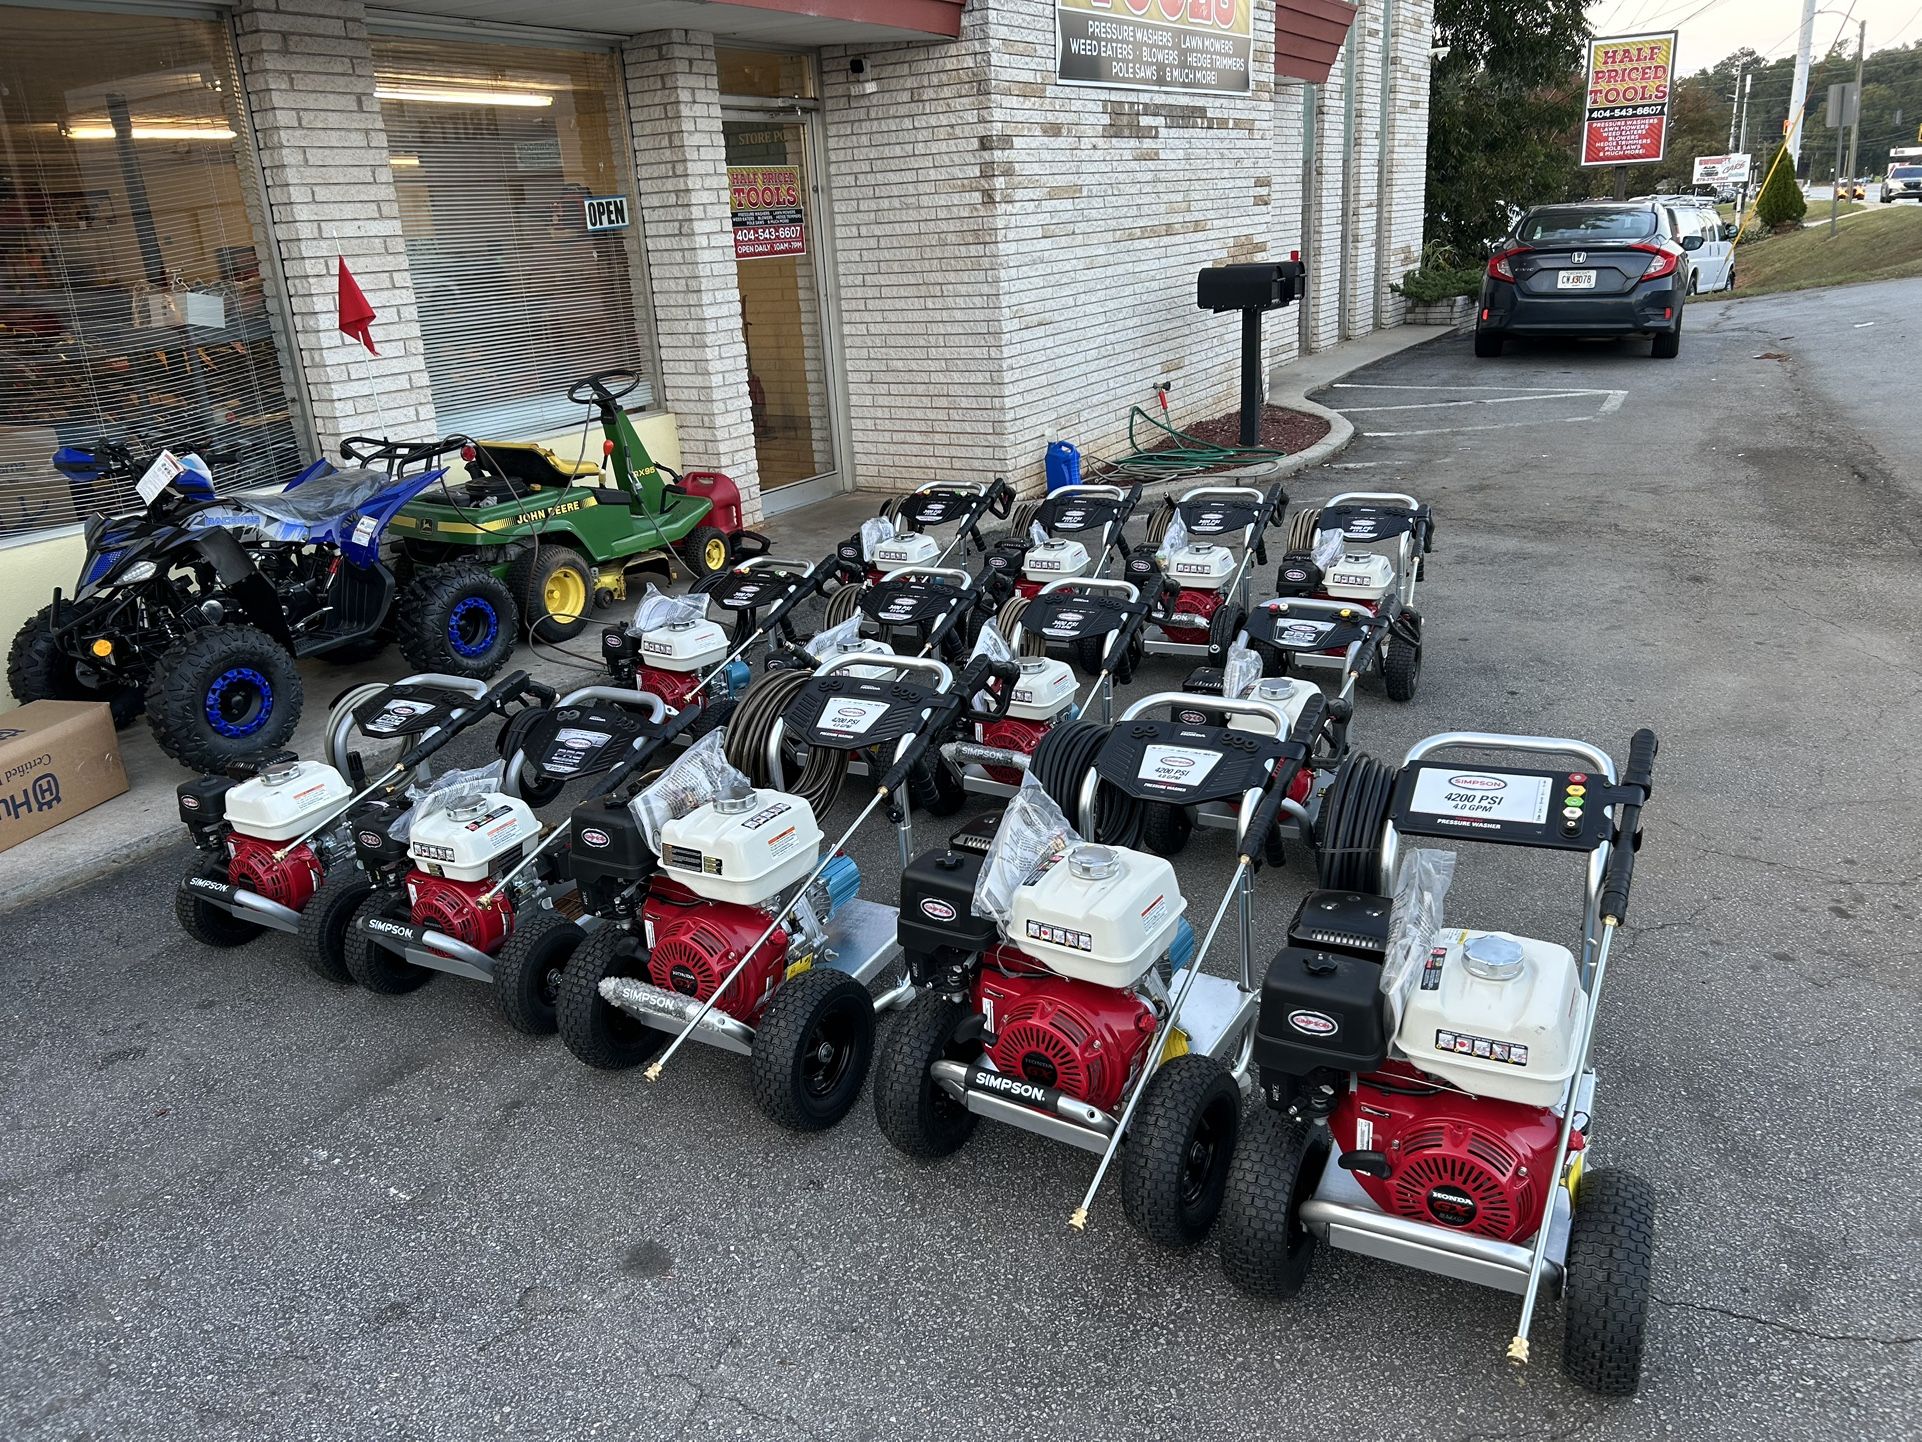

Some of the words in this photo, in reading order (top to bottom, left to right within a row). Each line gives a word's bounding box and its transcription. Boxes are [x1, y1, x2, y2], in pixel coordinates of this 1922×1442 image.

[1088, 20, 1134, 41] PRESSURE
[1135, 27, 1172, 47] WASHERS
[1181, 34, 1203, 50] LAWN
[1204, 37, 1234, 54] MOWERS
[1070, 37, 1098, 56] WEED
[1100, 41, 1134, 59] EATERS
[1142, 46, 1179, 65] BLOWERS
[1187, 52, 1211, 68] HEDGE
[1211, 54, 1245, 71] TRIMMERS
[1602, 45, 1662, 65] HALF
[1112, 61, 1134, 78] POLE
[1135, 63, 1157, 80] SAWS
[1166, 66, 1171, 81] &
[1172, 67, 1194, 83] MUCH
[1195, 70, 1218, 84] MORE!
[1592, 64, 1667, 85] PRICED
[1588, 83, 1669, 105] TOOLS
[1591, 106, 1661, 118] 404-543-6607
[1626, 118, 1658, 126] WASHERS
[738, 130, 771, 145] STORE
[731, 172, 758, 184] HALF
[761, 172, 795, 183] PRICED
[732, 185, 798, 209] TOOLS
[587, 199, 626, 227] OPEN
[736, 226, 801, 241] 404-543-6607
[737, 245, 754, 253] OPEN
[754, 244, 771, 252] DAILY
[773, 242, 802, 251] 10AM-7PM
[517, 508, 546, 524] JOHN
[831, 716, 848, 724] 4200
[962, 746, 1004, 759] SIMPSON
[5, 753, 51, 783] Certified
[1154, 767, 1174, 775] 4200
[1174, 769, 1190, 777] PSI
[1454, 778, 1502, 788] SIMPSON
[1444, 792, 1476, 804] 4200
[1477, 794, 1504, 806] PSI
[1452, 803, 1467, 811] 4.0
[1468, 804, 1493, 813] GPM
[1437, 818, 1471, 828] PRESSURE
[1471, 821, 1501, 830] WASHER
[190, 877, 229, 892] SIMPSON
[369, 919, 413, 938] SIMPSON
[672, 970, 695, 980] HONDA
[622, 988, 675, 1010] SIMPSON
[1432, 1191, 1474, 1206] HONDA
[1433, 1201, 1472, 1217] GX
